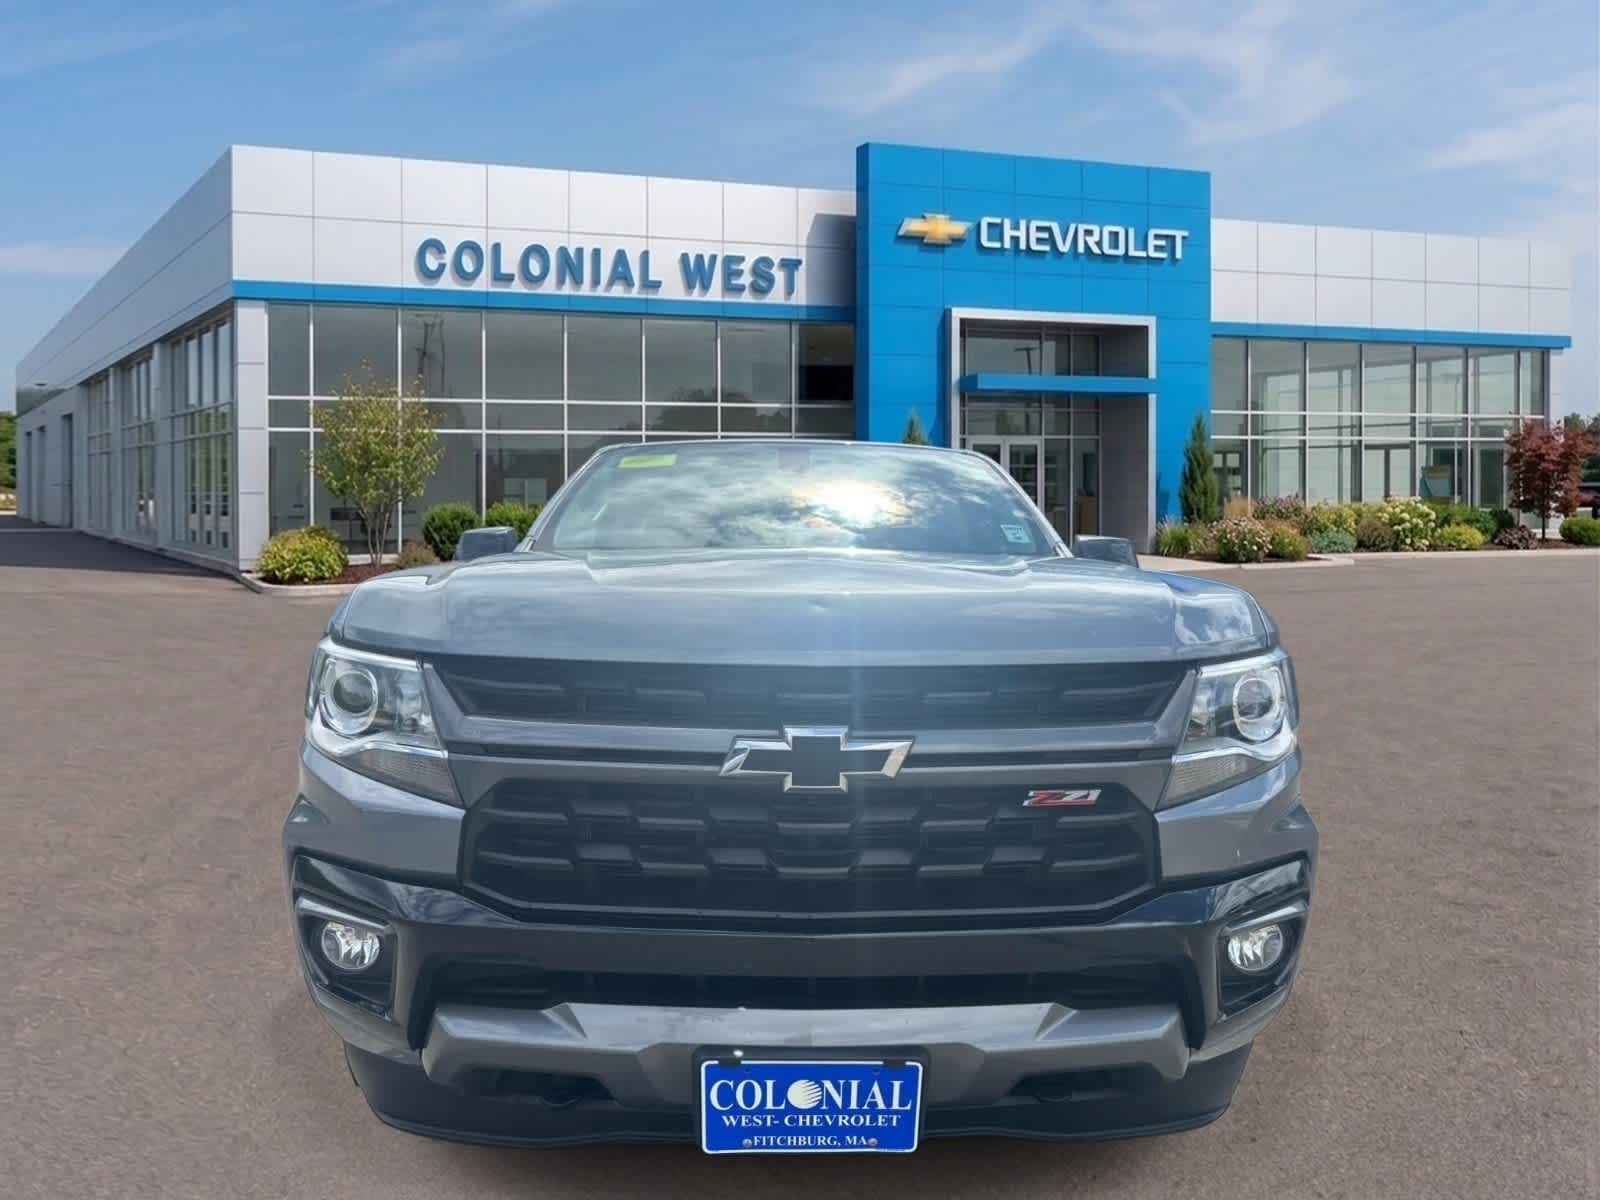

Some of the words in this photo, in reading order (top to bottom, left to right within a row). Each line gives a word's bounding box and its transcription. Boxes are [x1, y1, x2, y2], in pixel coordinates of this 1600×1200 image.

[980, 216, 1190, 260] CHEVROLET
[415, 238, 663, 289] COLONIAL
[680, 251, 803, 297] WEST
[710, 1079, 913, 1111] COLONIAL
[784, 1114, 901, 1127] CHEVROLET
[753, 1135, 841, 1146] FITCHBURG,
[845, 1135, 868, 1146] MA
